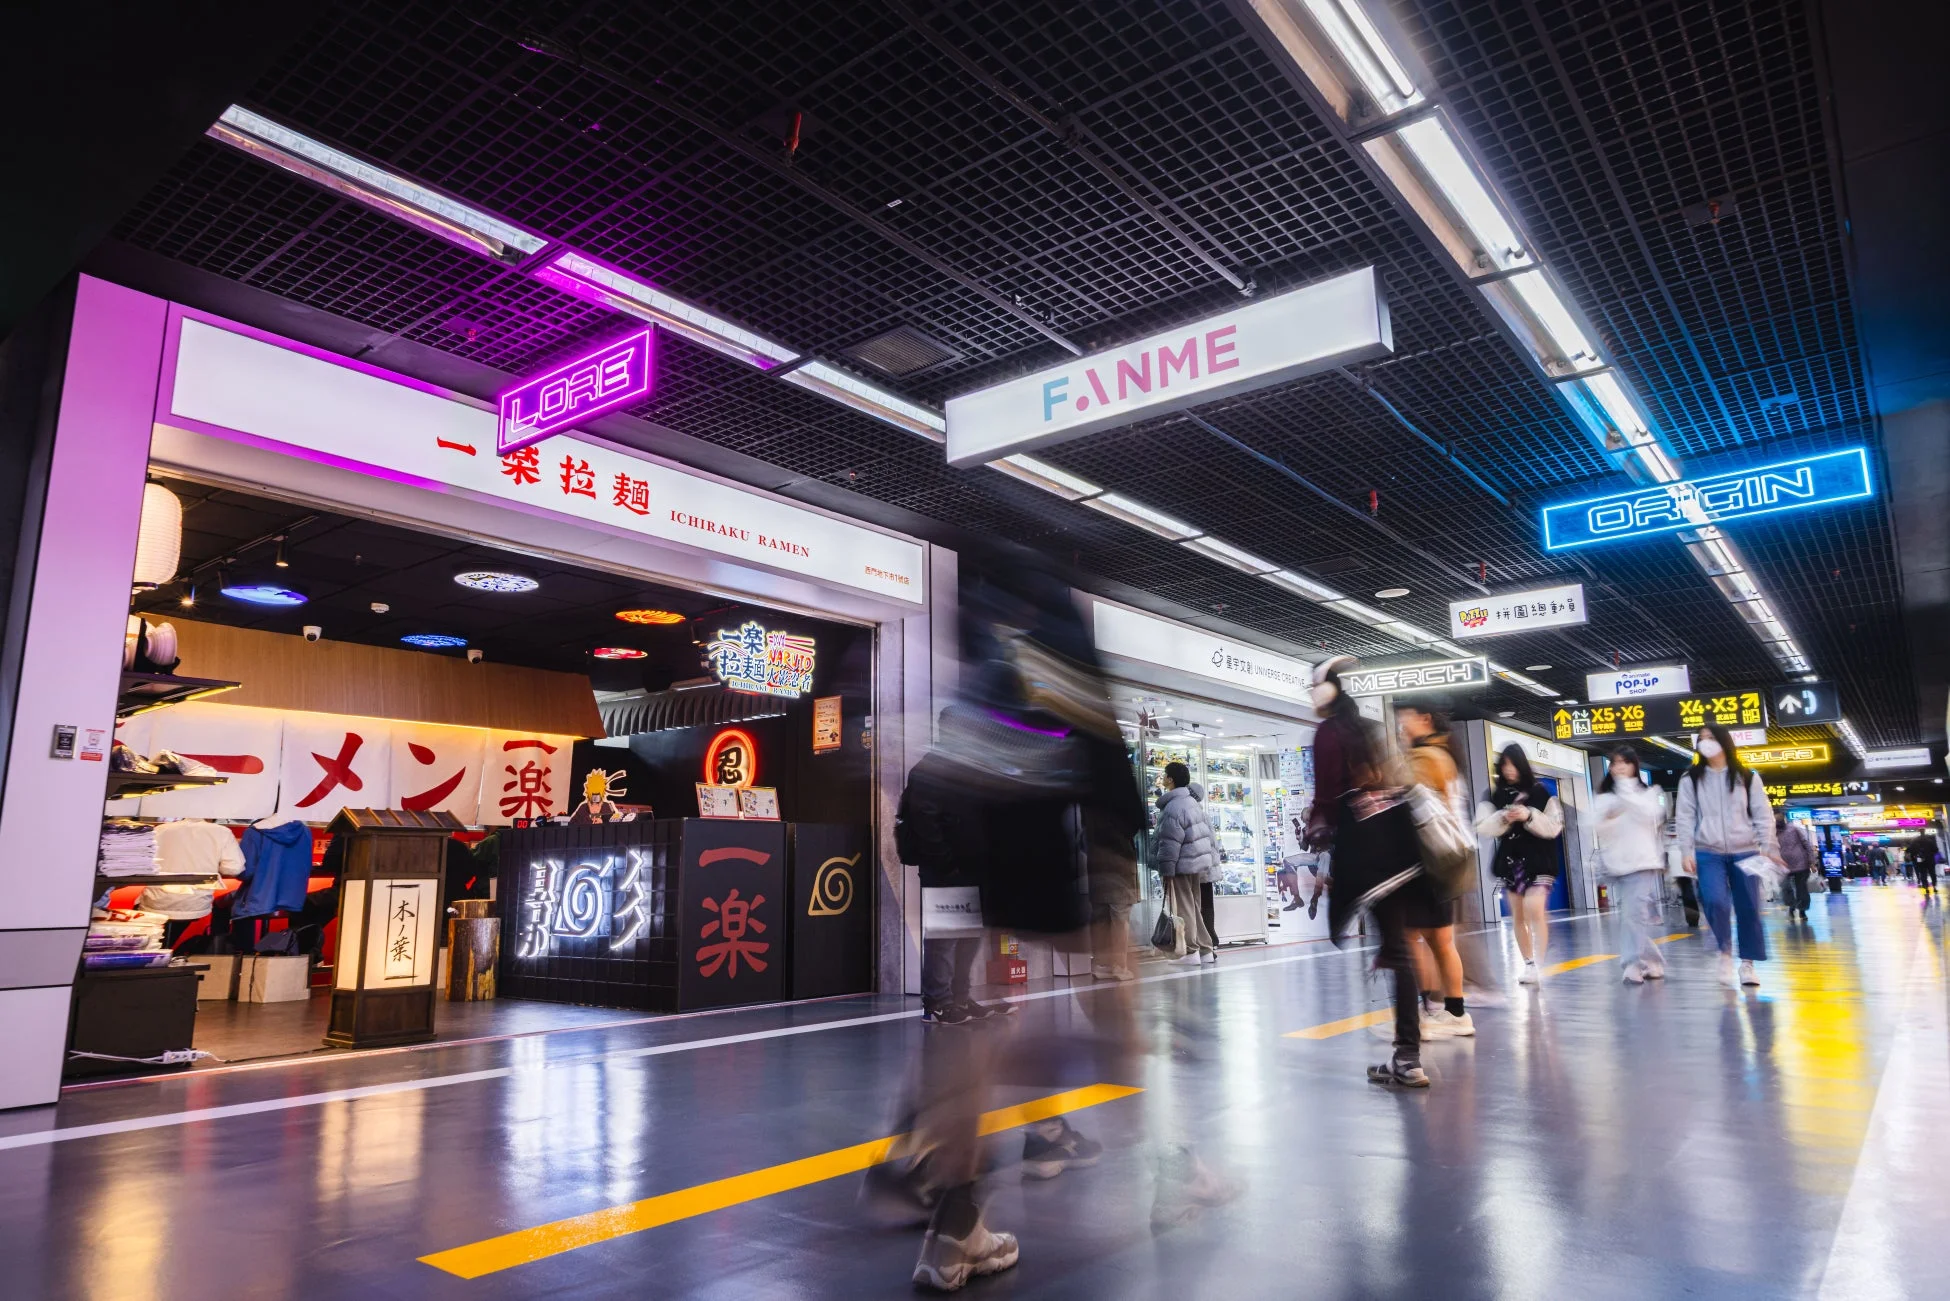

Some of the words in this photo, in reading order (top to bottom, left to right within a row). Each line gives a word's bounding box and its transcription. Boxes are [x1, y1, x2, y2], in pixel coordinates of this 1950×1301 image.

[511, 347, 635, 433] LORE
[1042, 324, 1240, 421] FANME
[1588, 466, 1815, 534] ORIGIN
[670, 510, 751, 542] ICHIRAKU
[758, 534, 810, 558] RAMEN
[767, 649, 813, 673] NARUTO
[1254, 665, 1281, 682] UNIVERSE
[1351, 663, 1472, 693] MERCH
[1556, 724, 1572, 739] 出口
[1742, 708, 1761, 724] 出口
[695, 846, 771, 979] 一楽
